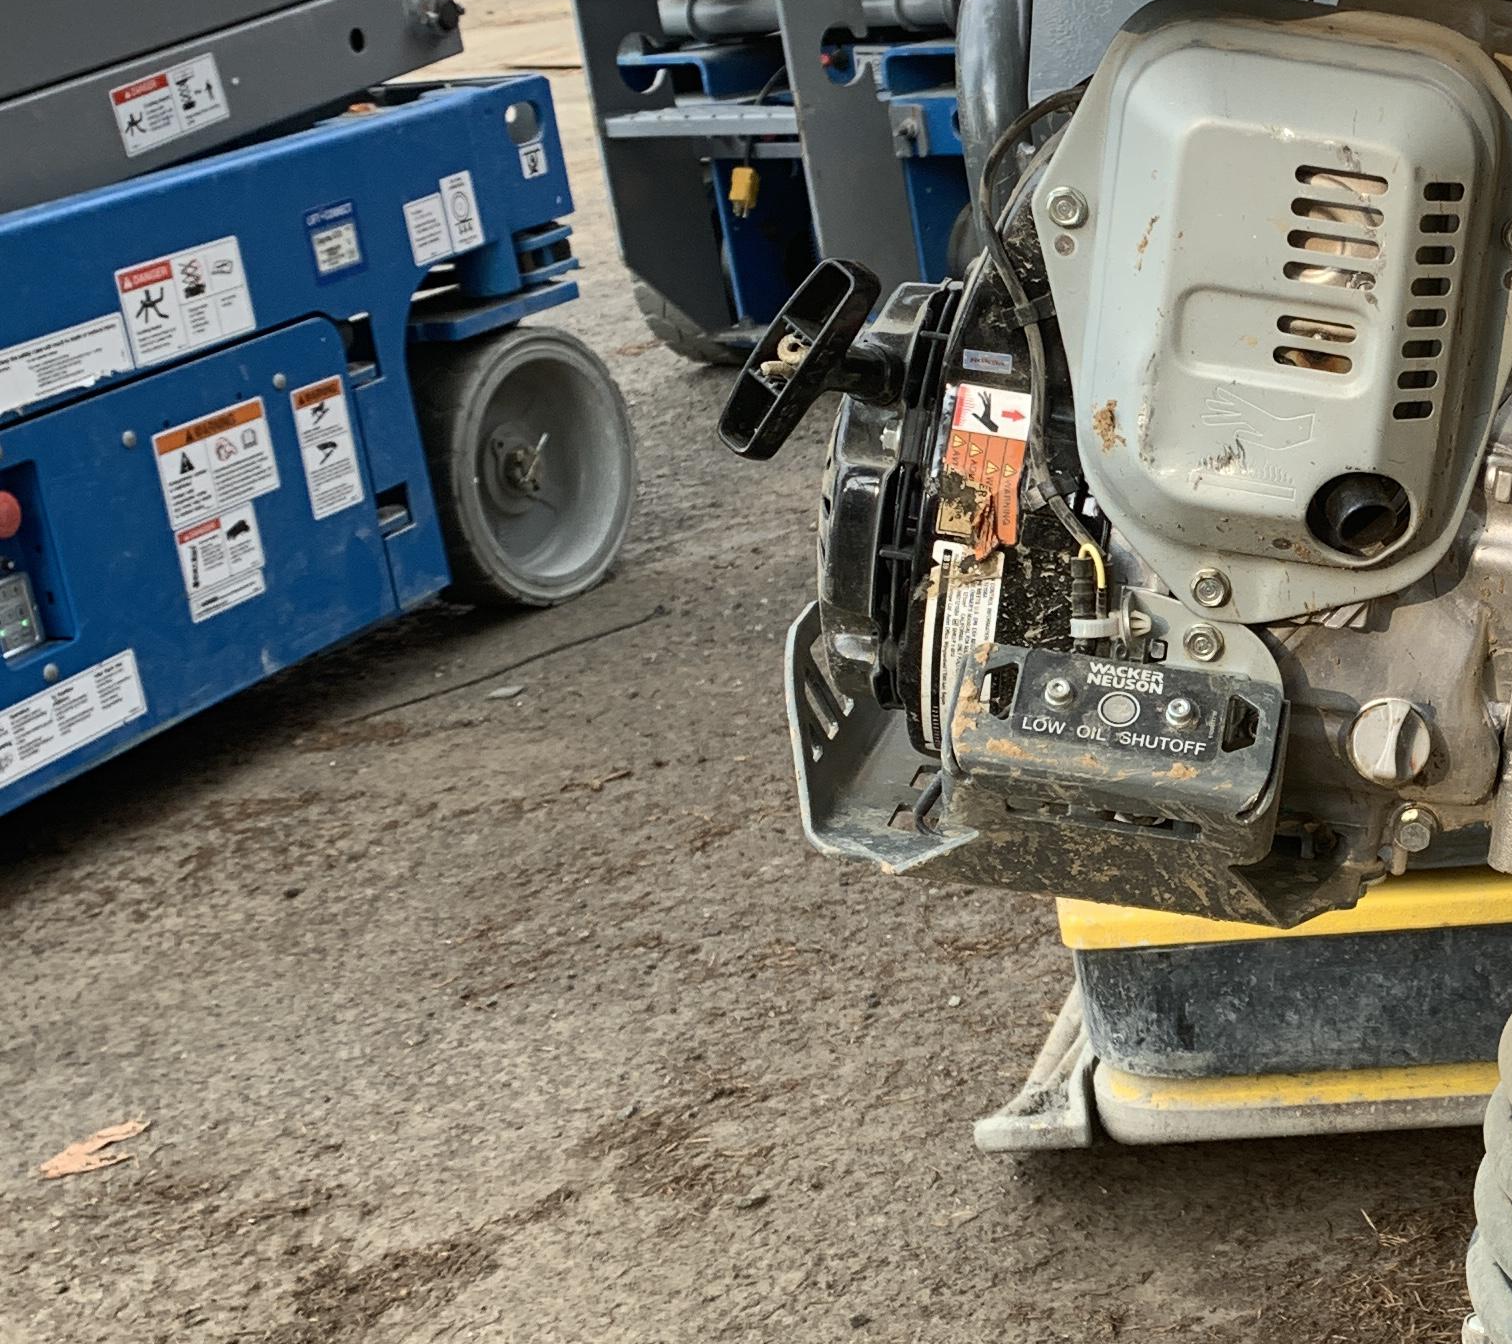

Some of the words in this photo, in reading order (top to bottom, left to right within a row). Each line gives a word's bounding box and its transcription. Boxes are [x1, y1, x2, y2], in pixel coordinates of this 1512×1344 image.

[1086, 673, 1164, 695] NEUSON
[1089, 661, 1164, 684] WACKER
[1022, 716, 1067, 735] LOW
[1076, 725, 1107, 742] OIL
[1119, 731, 1206, 756] SHUTOFF
